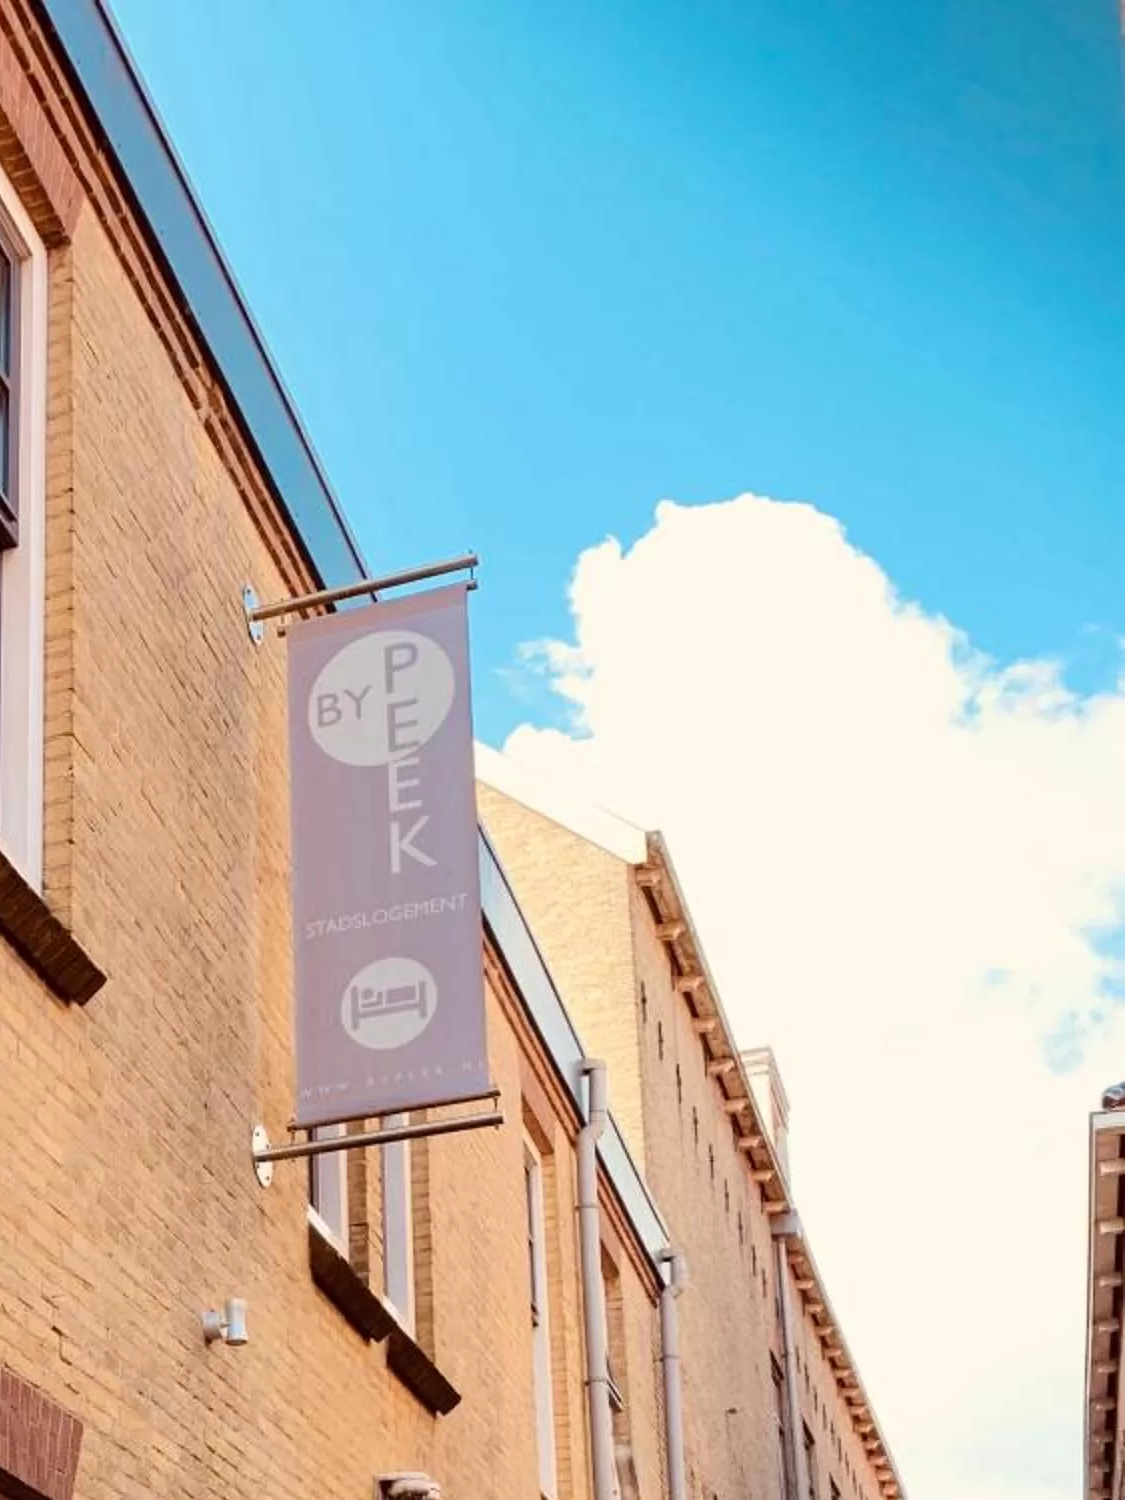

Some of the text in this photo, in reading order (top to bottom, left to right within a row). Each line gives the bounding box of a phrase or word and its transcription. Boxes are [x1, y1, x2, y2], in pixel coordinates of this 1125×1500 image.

[317, 684, 373, 728] BY
[383, 641, 439, 875] PEEK
[305, 892, 469, 940] STADSLOGEMENT
